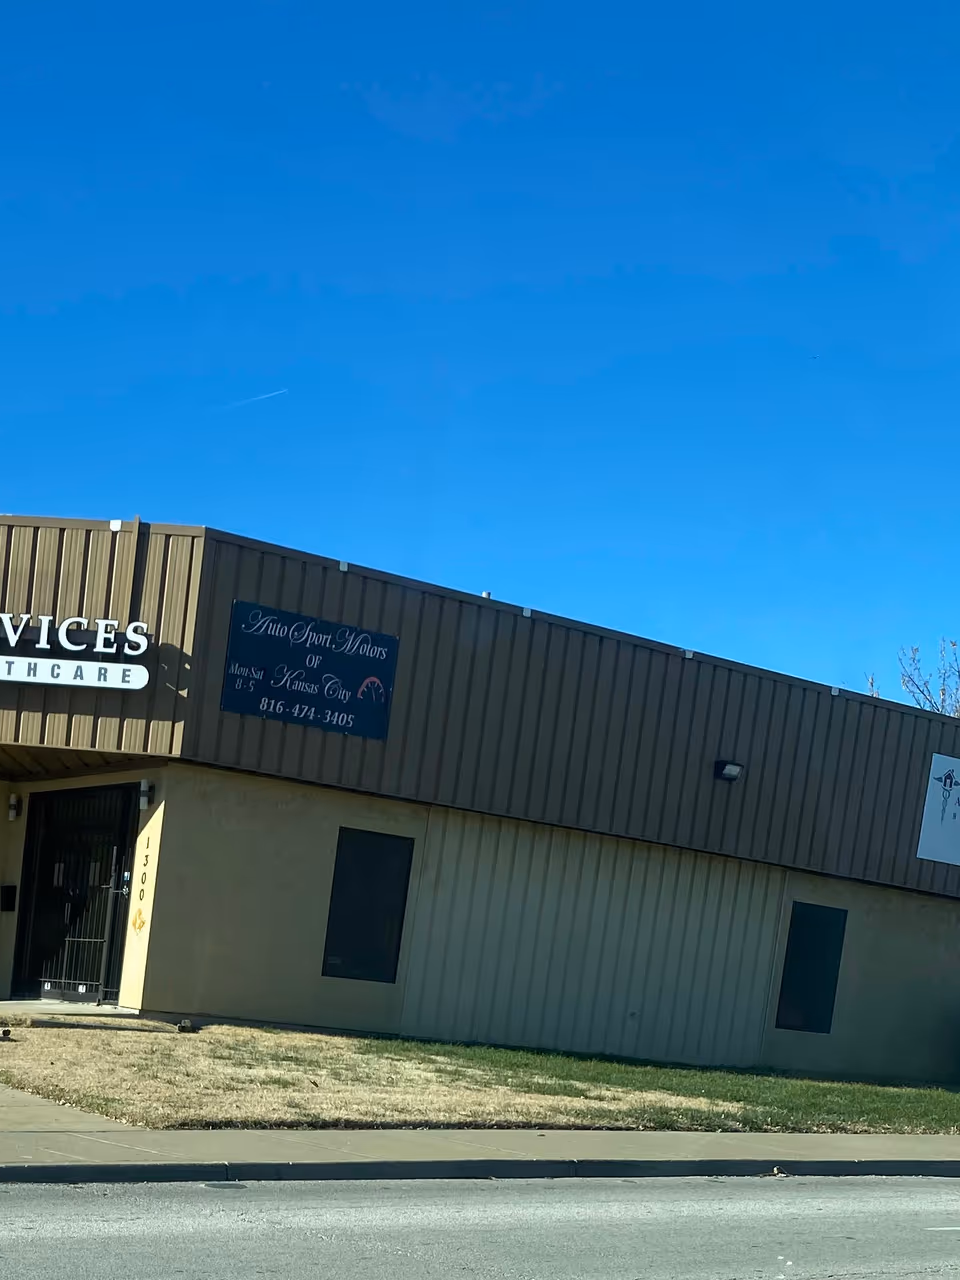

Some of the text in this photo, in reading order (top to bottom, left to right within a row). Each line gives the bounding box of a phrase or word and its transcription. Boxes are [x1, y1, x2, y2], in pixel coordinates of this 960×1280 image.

[241, 610, 388, 660] Auto Sport Motors
[305, 653, 323, 669] OF
[270, 664, 352, 703] Kansas City
[139, 836, 151, 901] 1300
